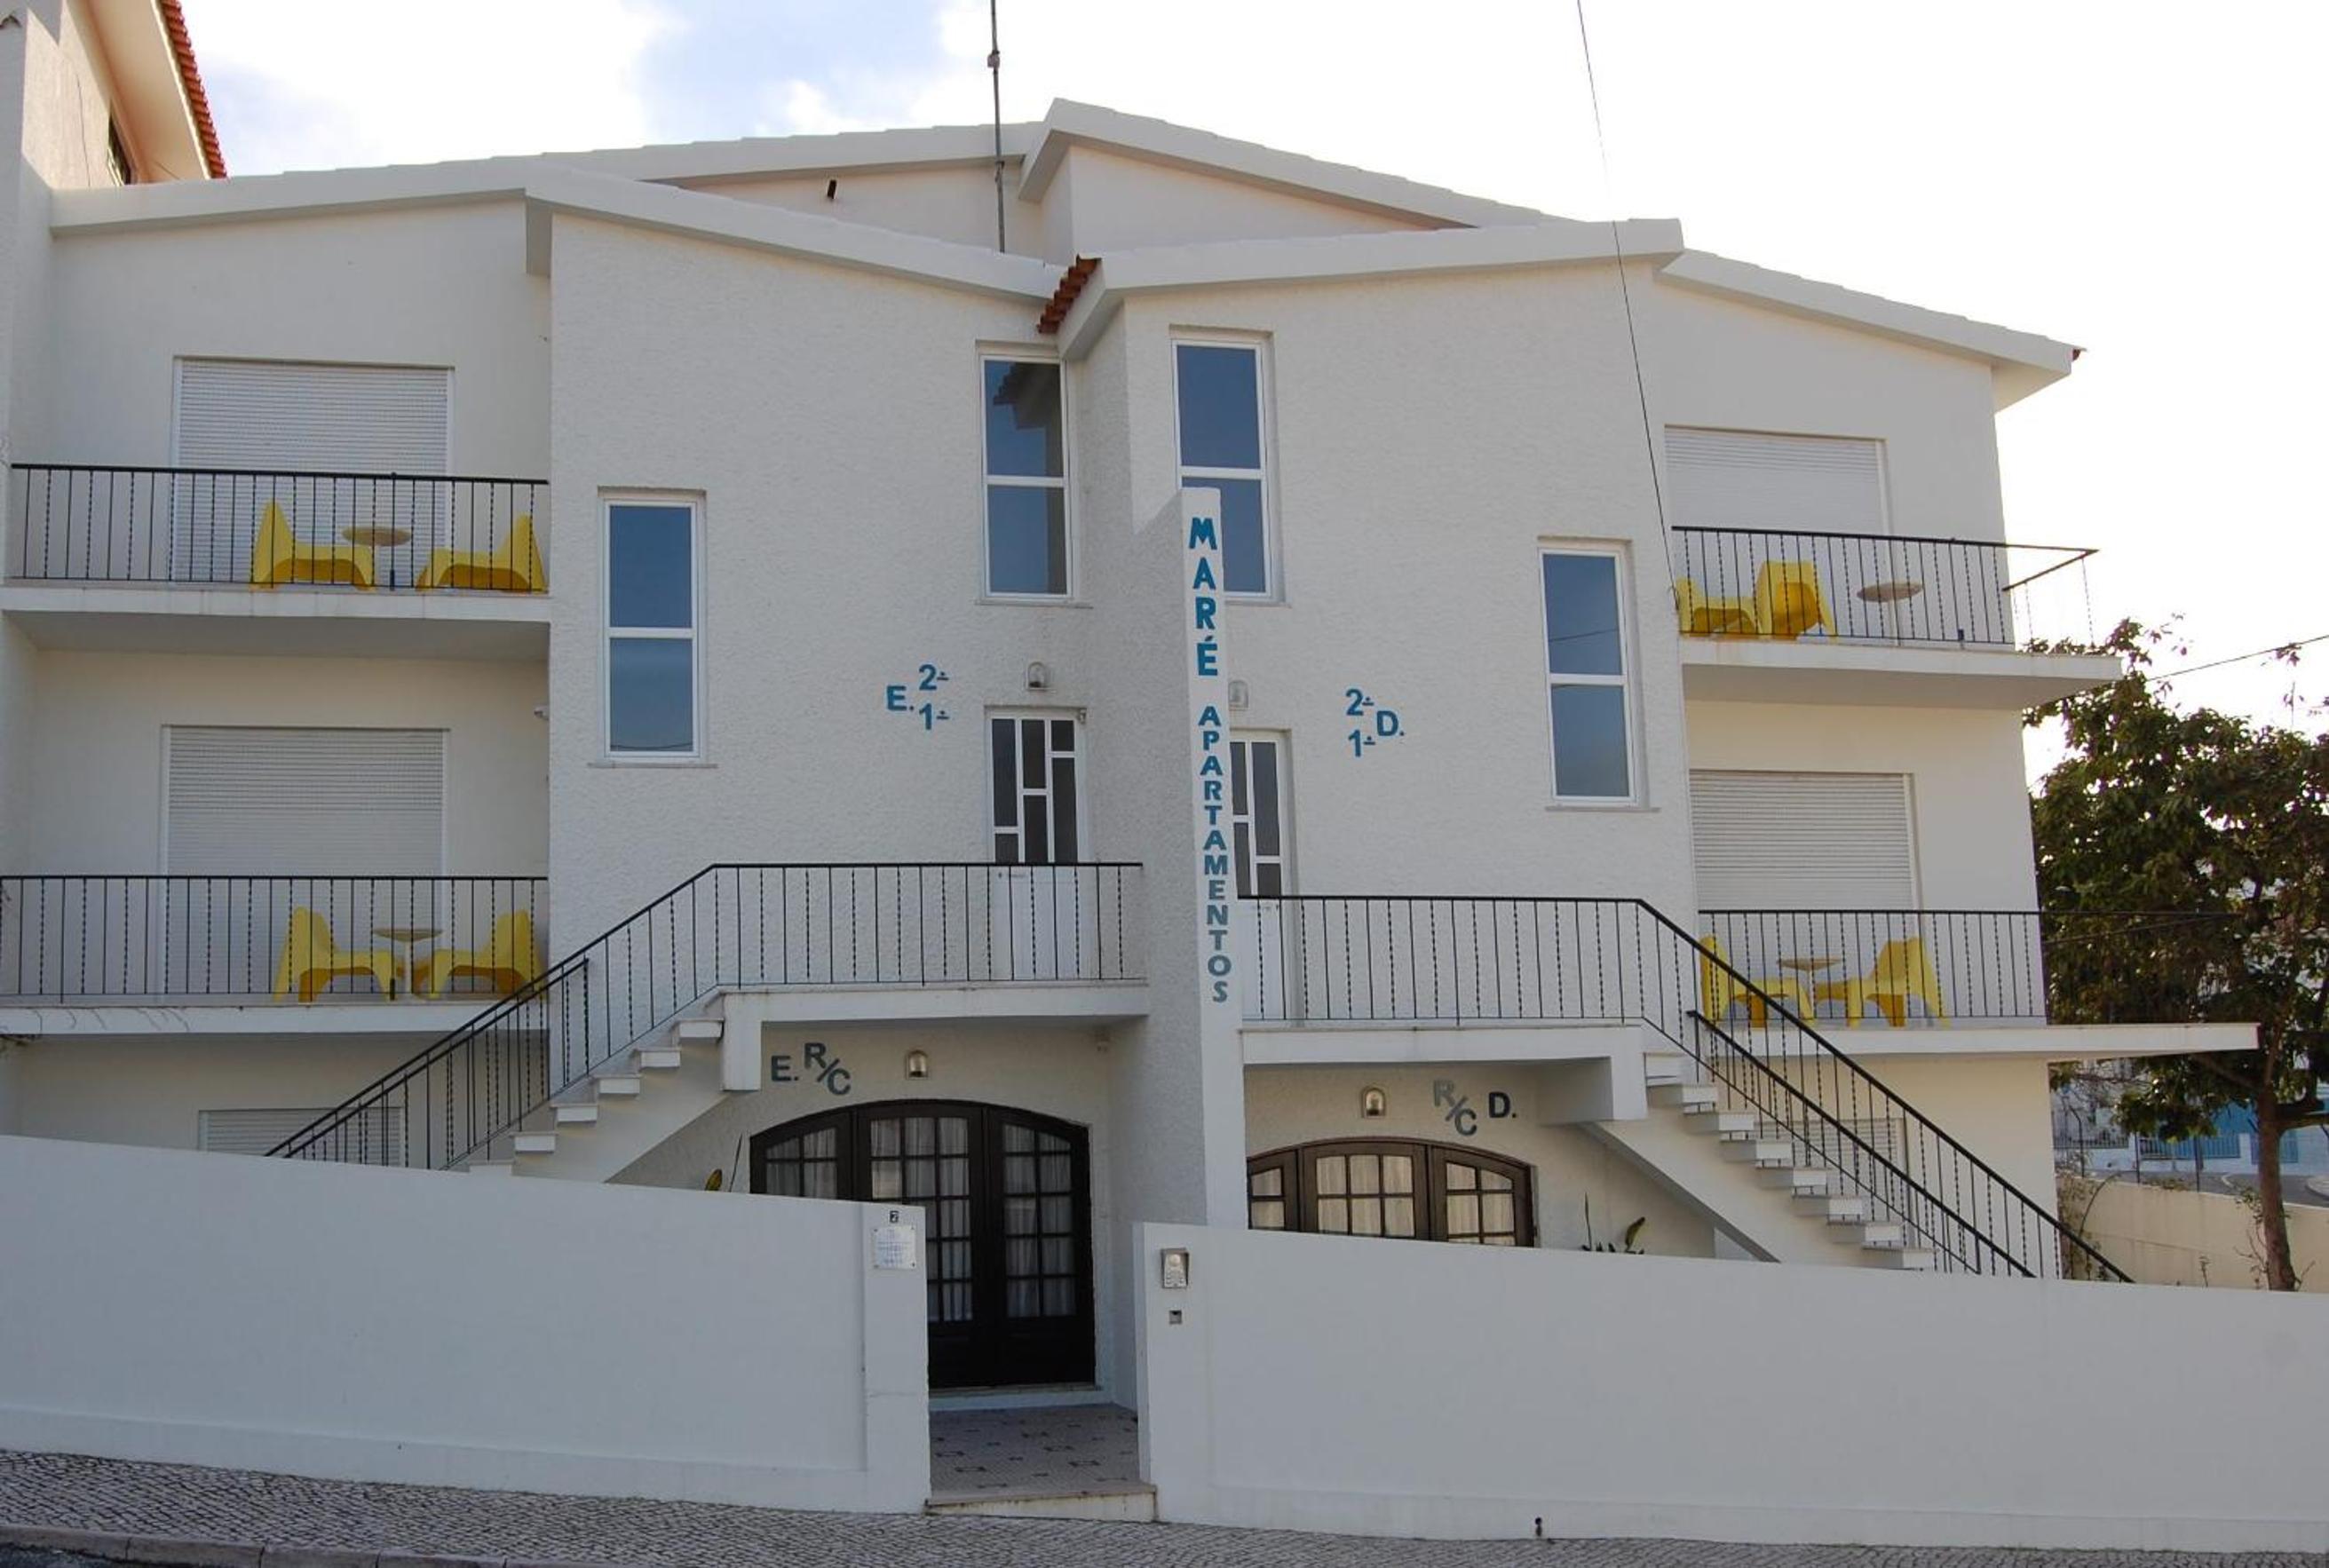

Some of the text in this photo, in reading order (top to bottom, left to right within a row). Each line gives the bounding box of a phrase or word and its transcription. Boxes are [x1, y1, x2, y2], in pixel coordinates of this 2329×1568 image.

[885, 685, 915, 711] E.
[1375, 709, 1405, 737] D.
[1188, 517, 1232, 1003] MARÉ APARTAMENTOS
[770, 1054, 799, 1082] E.
[1488, 1090, 1517, 1119] D.
